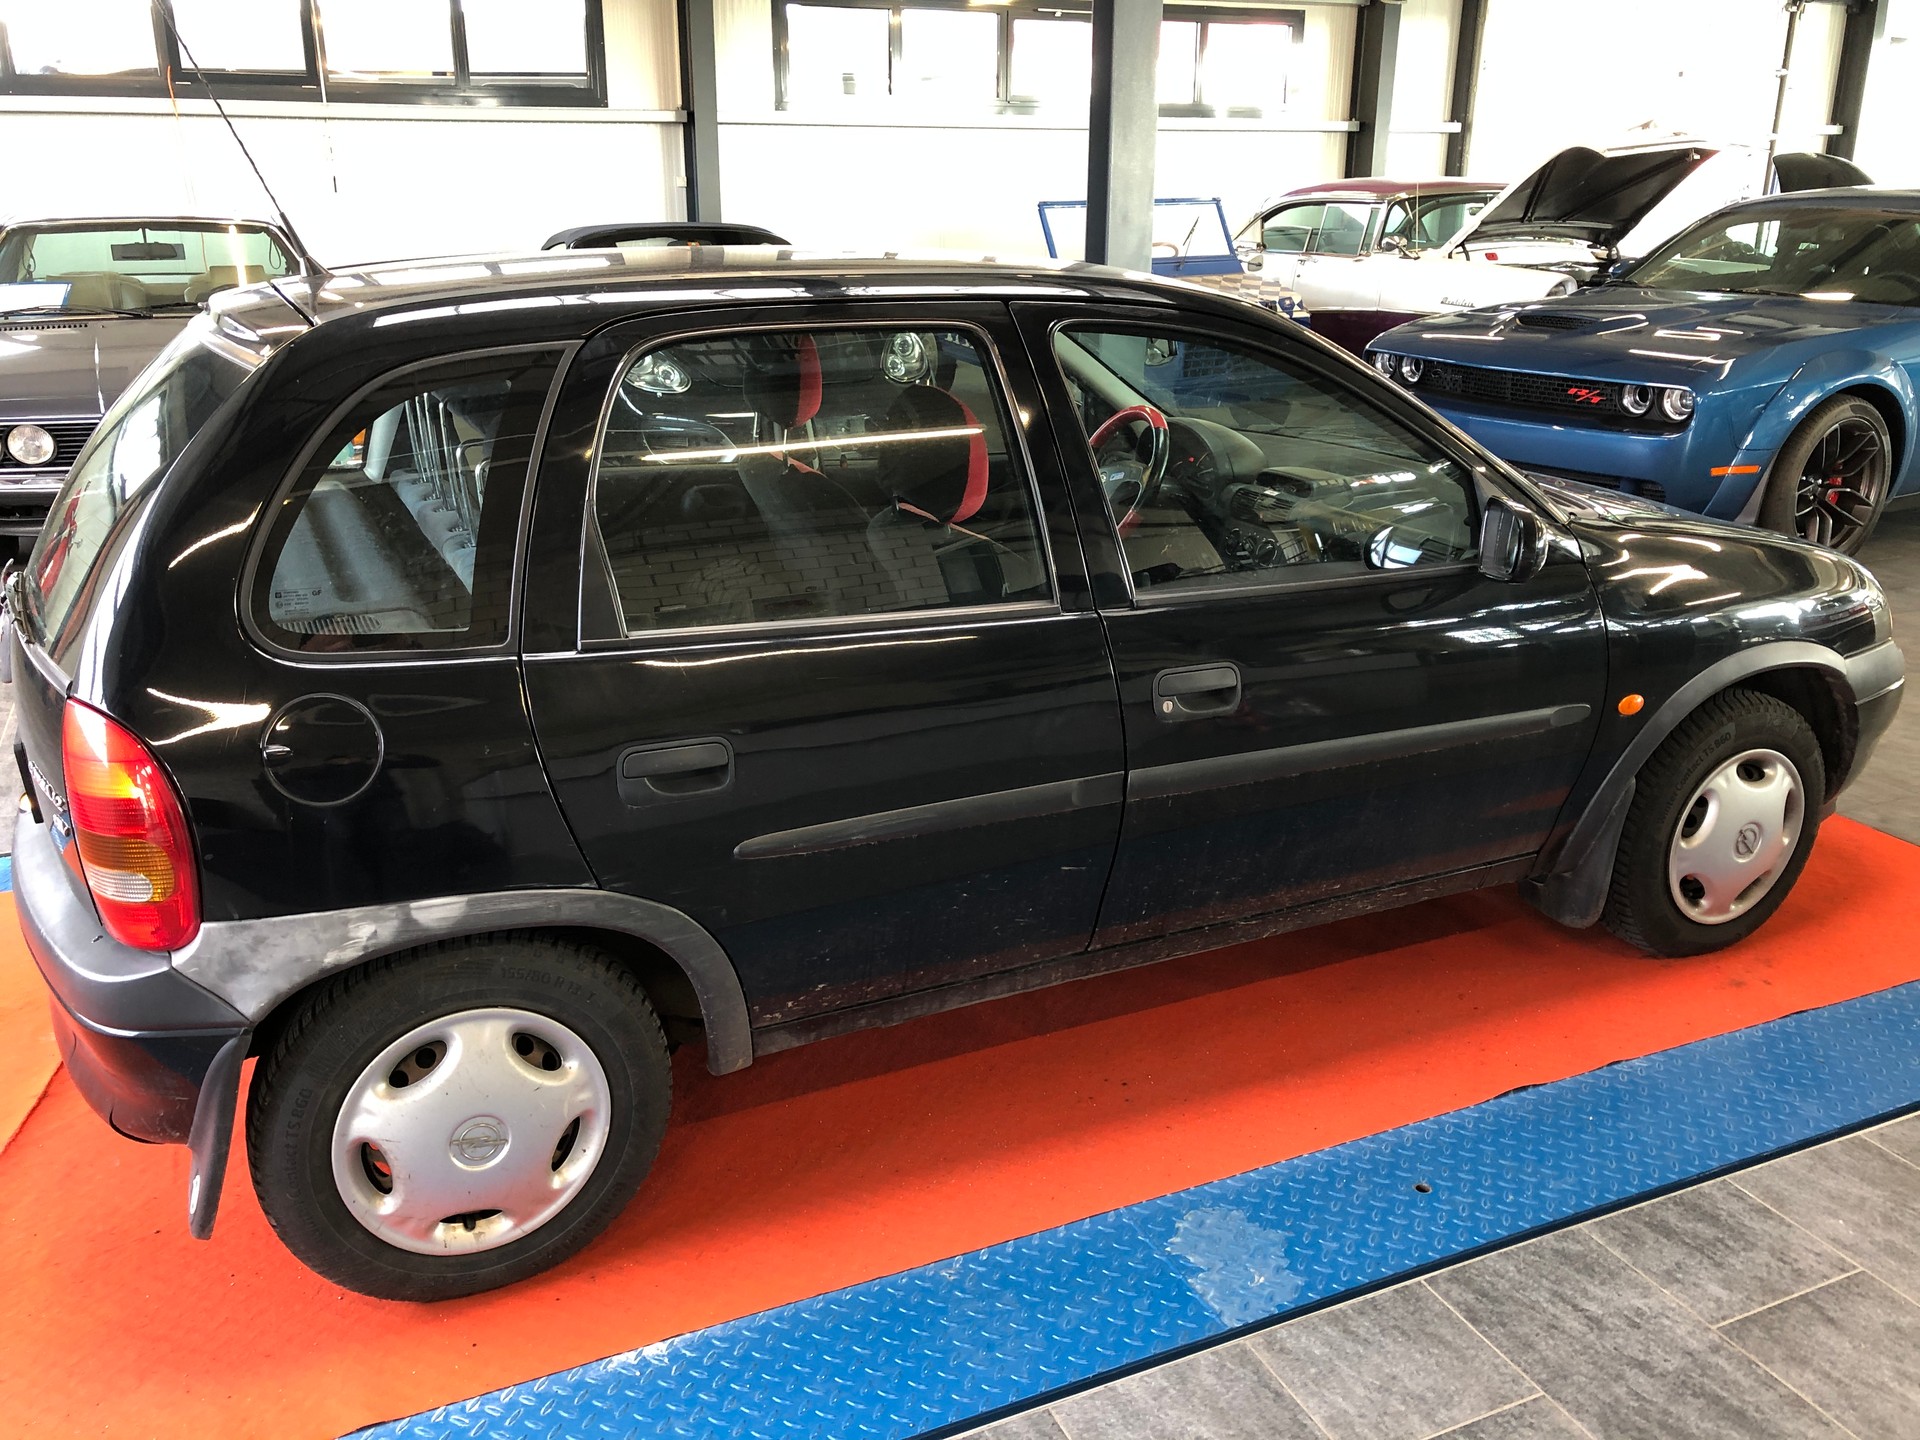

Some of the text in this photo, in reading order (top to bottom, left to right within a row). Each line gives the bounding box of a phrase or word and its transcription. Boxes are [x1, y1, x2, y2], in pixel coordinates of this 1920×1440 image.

[1567, 387, 1607, 404] R/T
[1702, 743, 1715, 757] TS
[1713, 732, 1732, 749] 860
[500, 966, 552, 985] 155/80
[284, 1119, 302, 1140] TS
